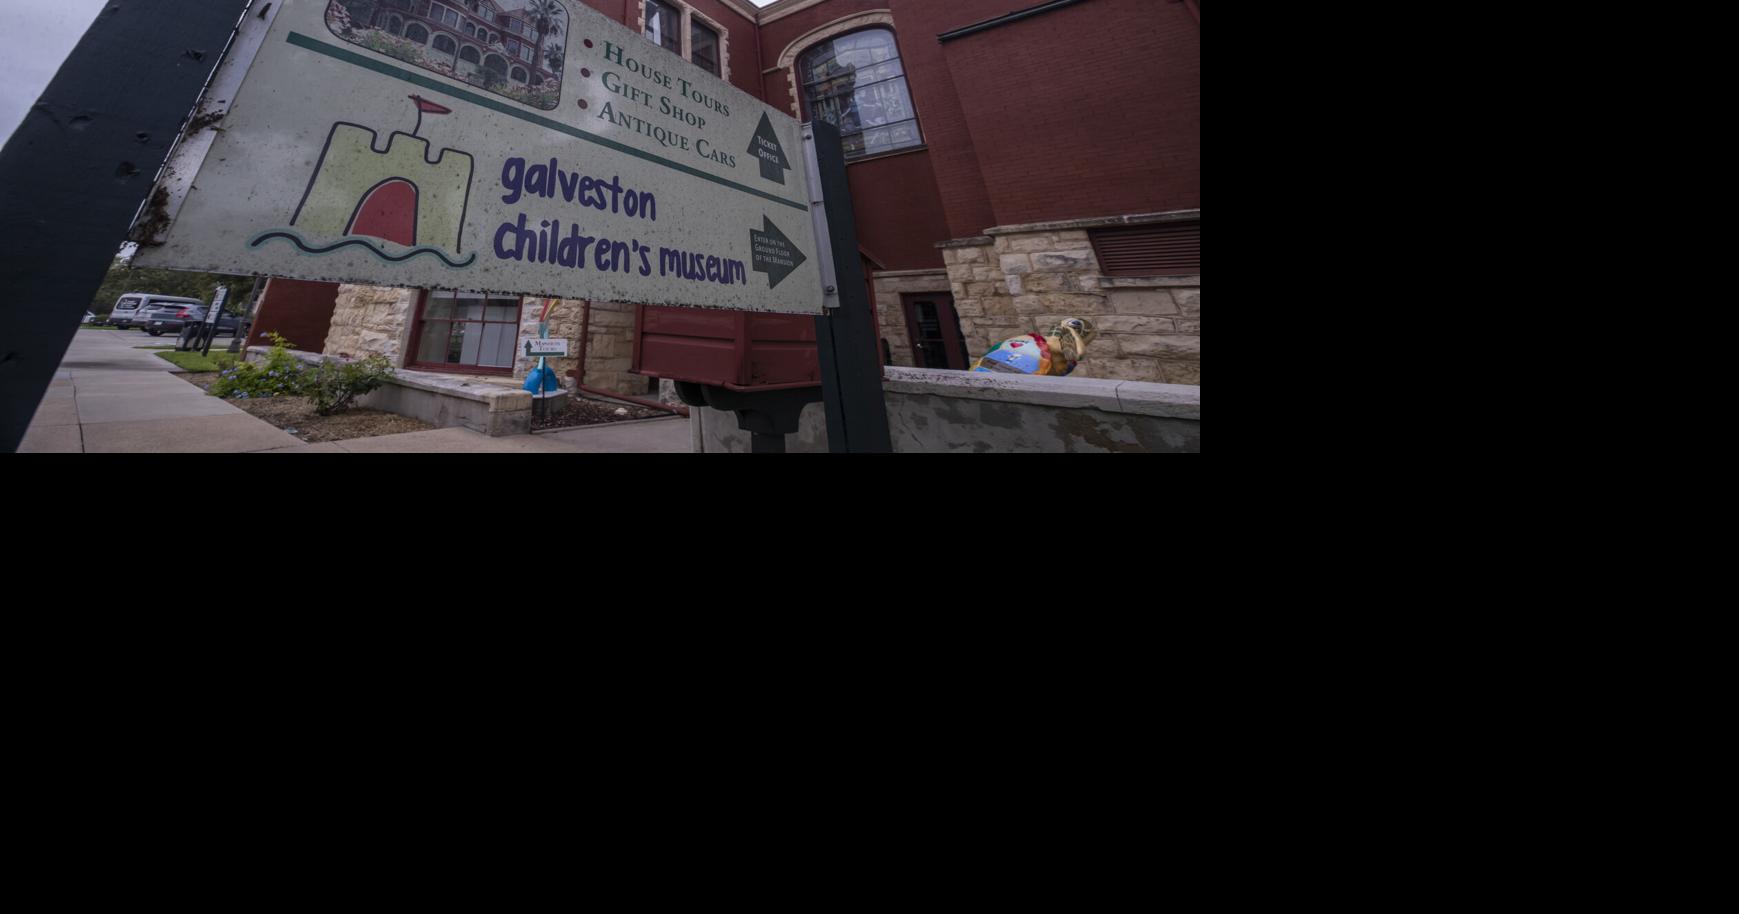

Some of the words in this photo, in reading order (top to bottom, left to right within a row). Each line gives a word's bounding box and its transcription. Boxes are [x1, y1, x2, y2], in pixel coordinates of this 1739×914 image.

[601, 71, 652, 108] GIFT
[659, 95, 706, 130] SHOP
[603, 40, 672, 89] HOUSE
[677, 77, 730, 117] TOURS
[597, 101, 689, 151] ANTIQUE
[695, 139, 736, 169] CARS
[757, 135, 777, 152] TICKET
[758, 148, 779, 163] OFFICE
[501, 157, 656, 222] galveston
[493, 213, 651, 277] children's
[659, 246, 747, 286] museum
